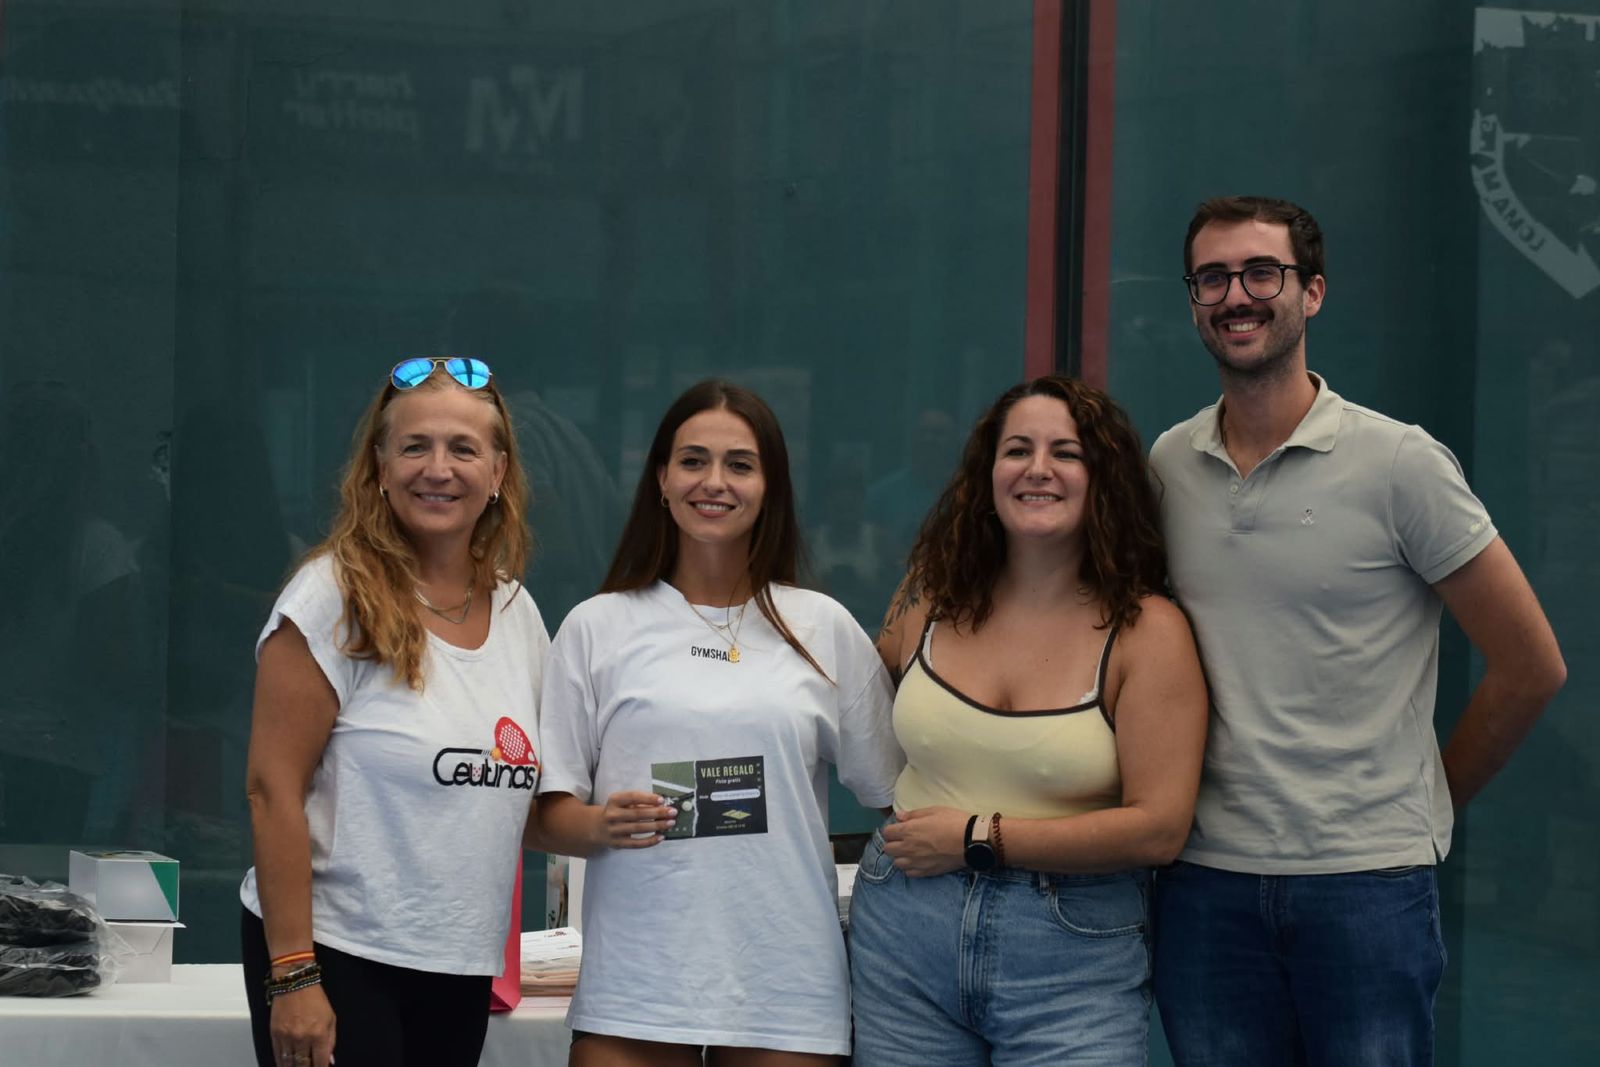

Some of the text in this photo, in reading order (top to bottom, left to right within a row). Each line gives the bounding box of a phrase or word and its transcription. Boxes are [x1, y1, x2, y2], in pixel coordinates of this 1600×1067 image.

[691, 646, 740, 663] GYMSHA
[433, 747, 536, 790] Ceutinas
[700, 764, 754, 778] VALE REGALO
